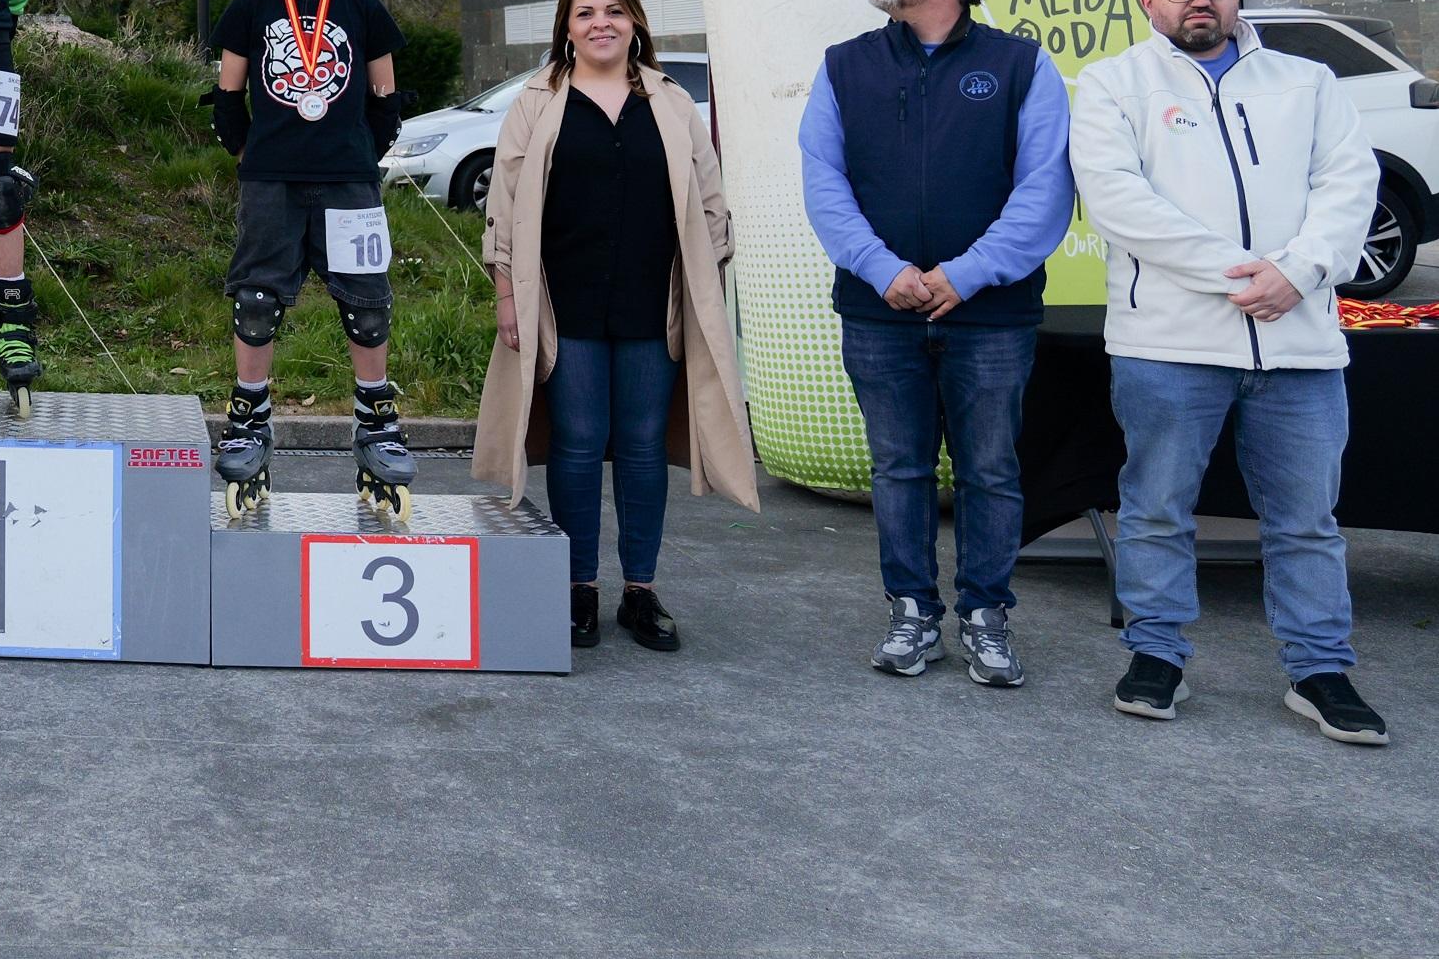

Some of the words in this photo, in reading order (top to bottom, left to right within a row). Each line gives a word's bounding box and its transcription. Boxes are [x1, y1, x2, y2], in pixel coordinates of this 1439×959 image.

[350, 233, 383, 267] 10
[130, 448, 200, 460] SOFTEE
[360, 556, 420, 647] 3
